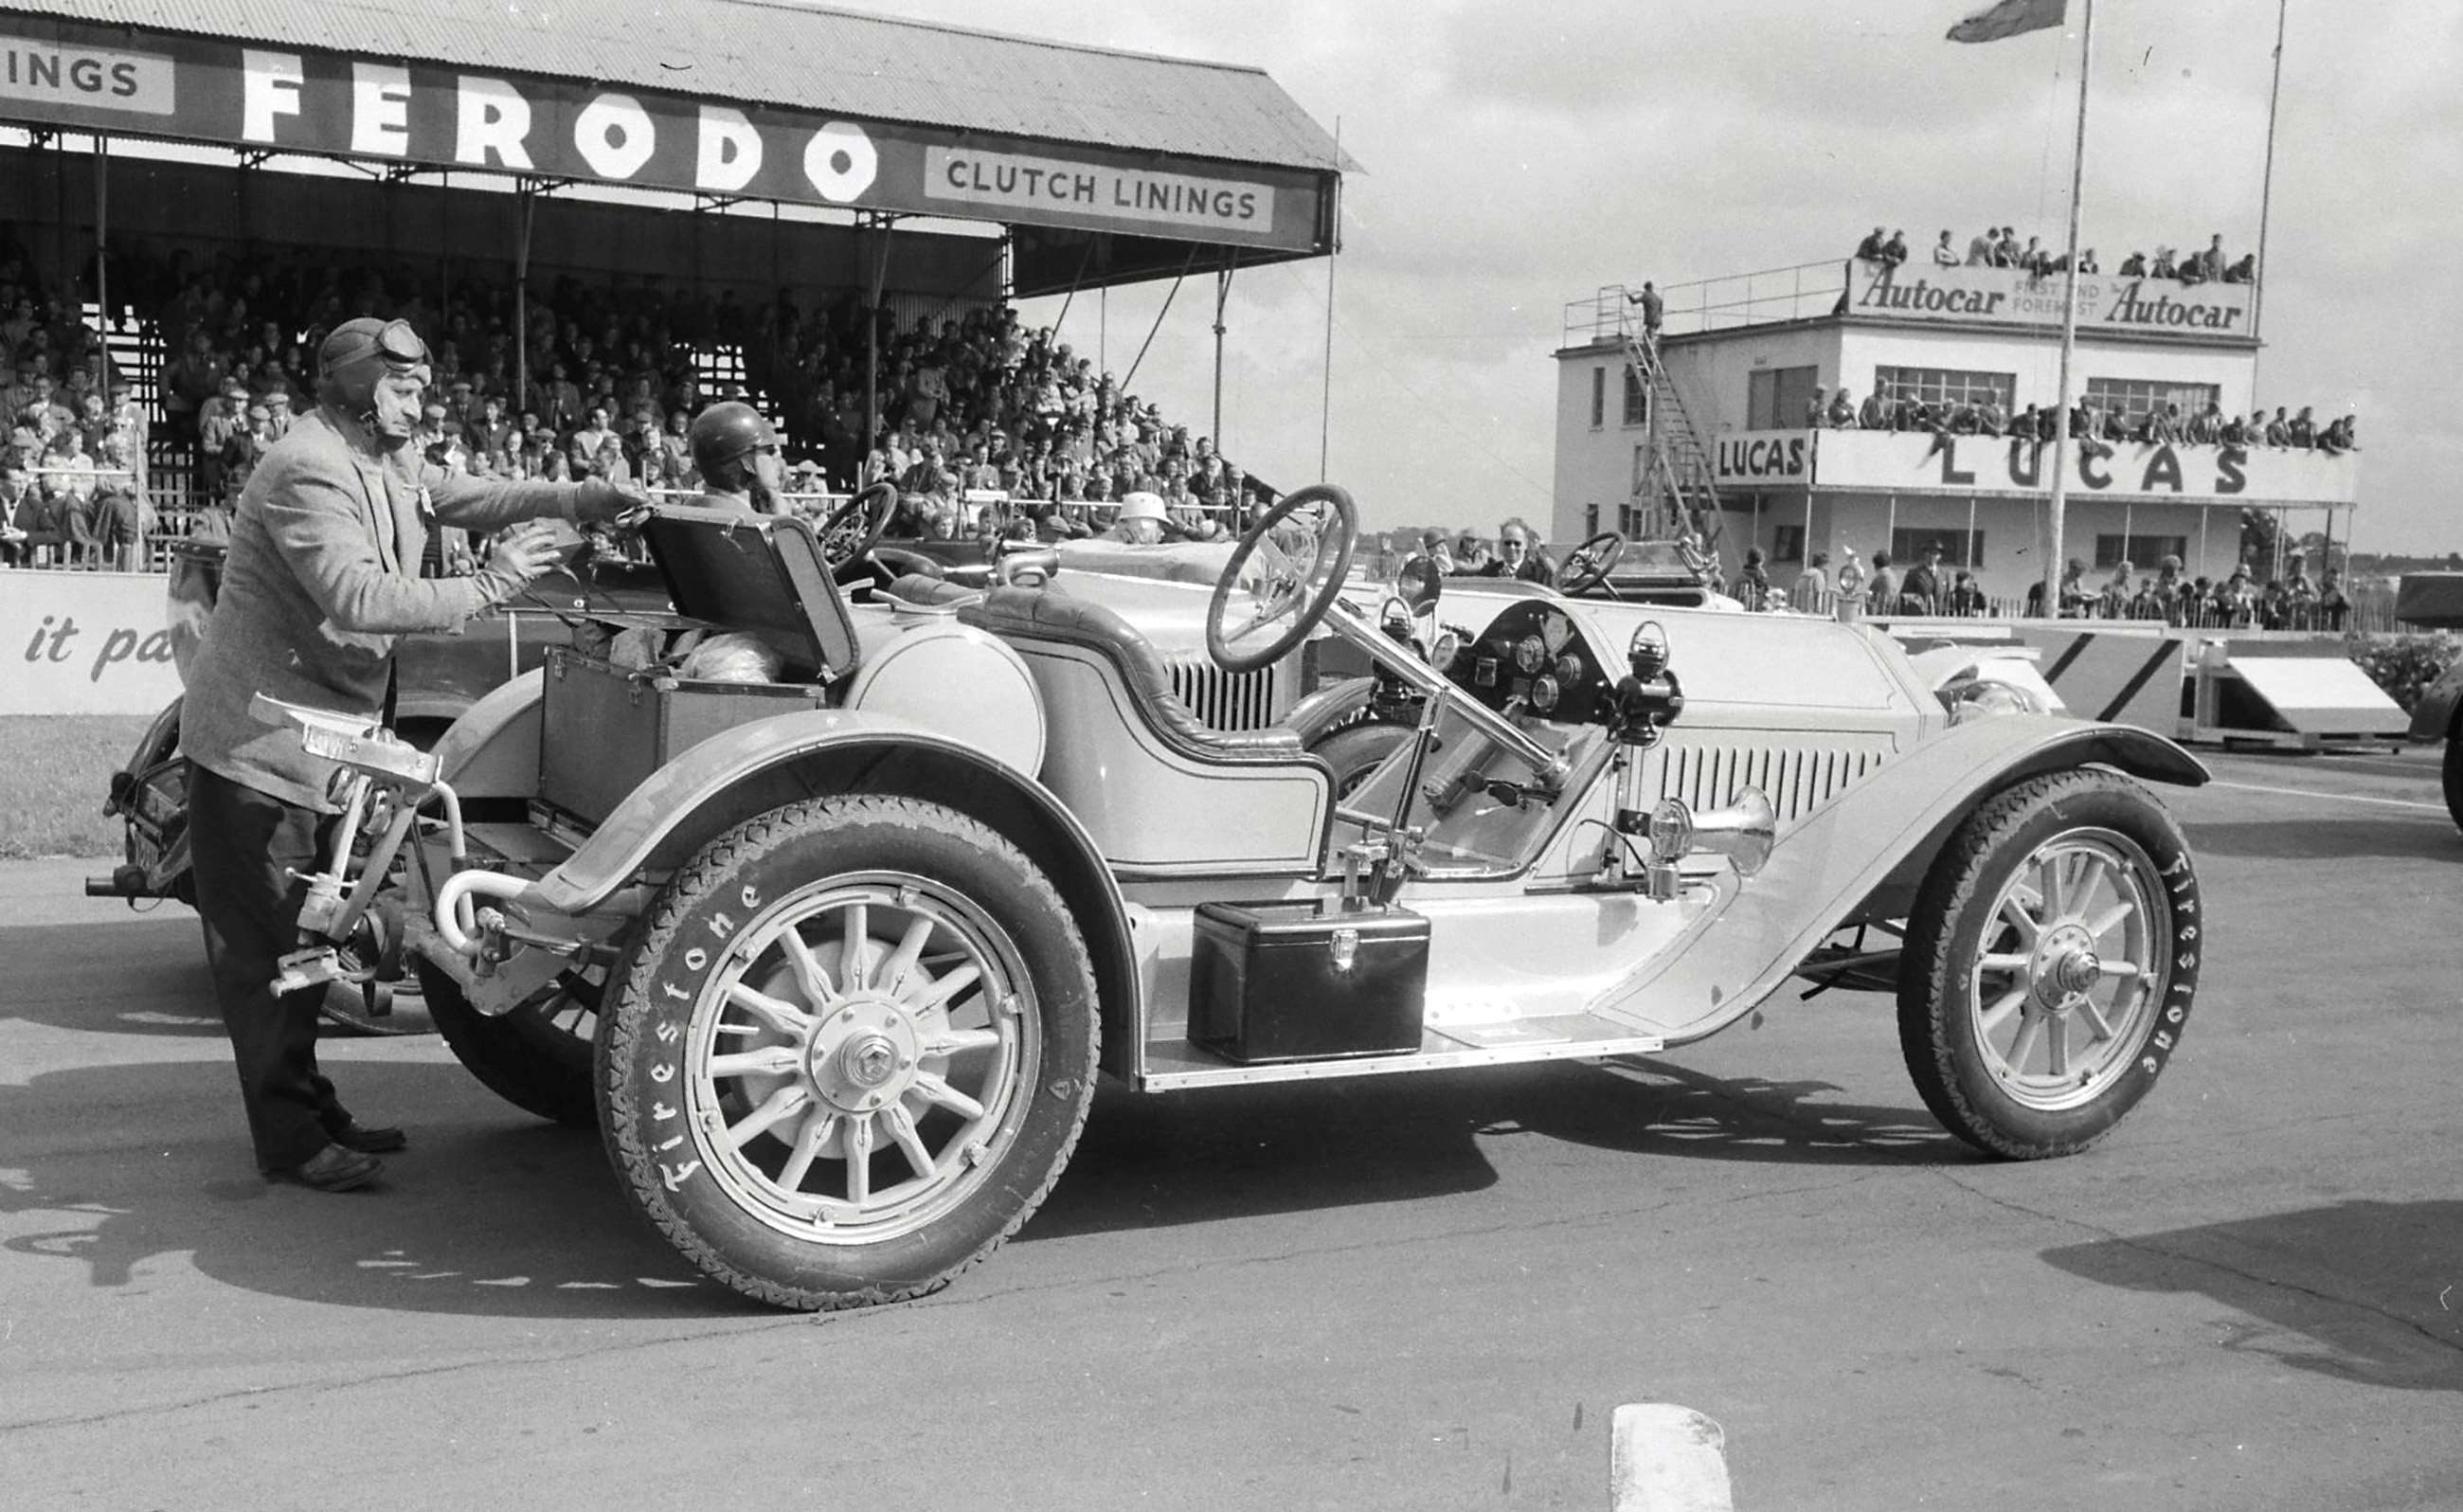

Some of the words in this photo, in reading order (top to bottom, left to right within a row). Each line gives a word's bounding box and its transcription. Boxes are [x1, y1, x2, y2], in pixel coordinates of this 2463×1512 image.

[243, 48, 877, 202] FERODO
[947, 160, 1096, 204] CLUTCH
[1114, 178, 1256, 220] LININGS
[1858, 263, 2005, 314] Autocar
[2013, 297, 2097, 315] FOREMST
[2104, 280, 2241, 328] Autocar
[1720, 439, 1804, 476] LUCAS
[1942, 437, 2248, 495] LUCAS
[25, 615, 80, 662] it
[2143, 851, 2198, 1073] Firestone
[651, 885, 761, 1193] Firestone
